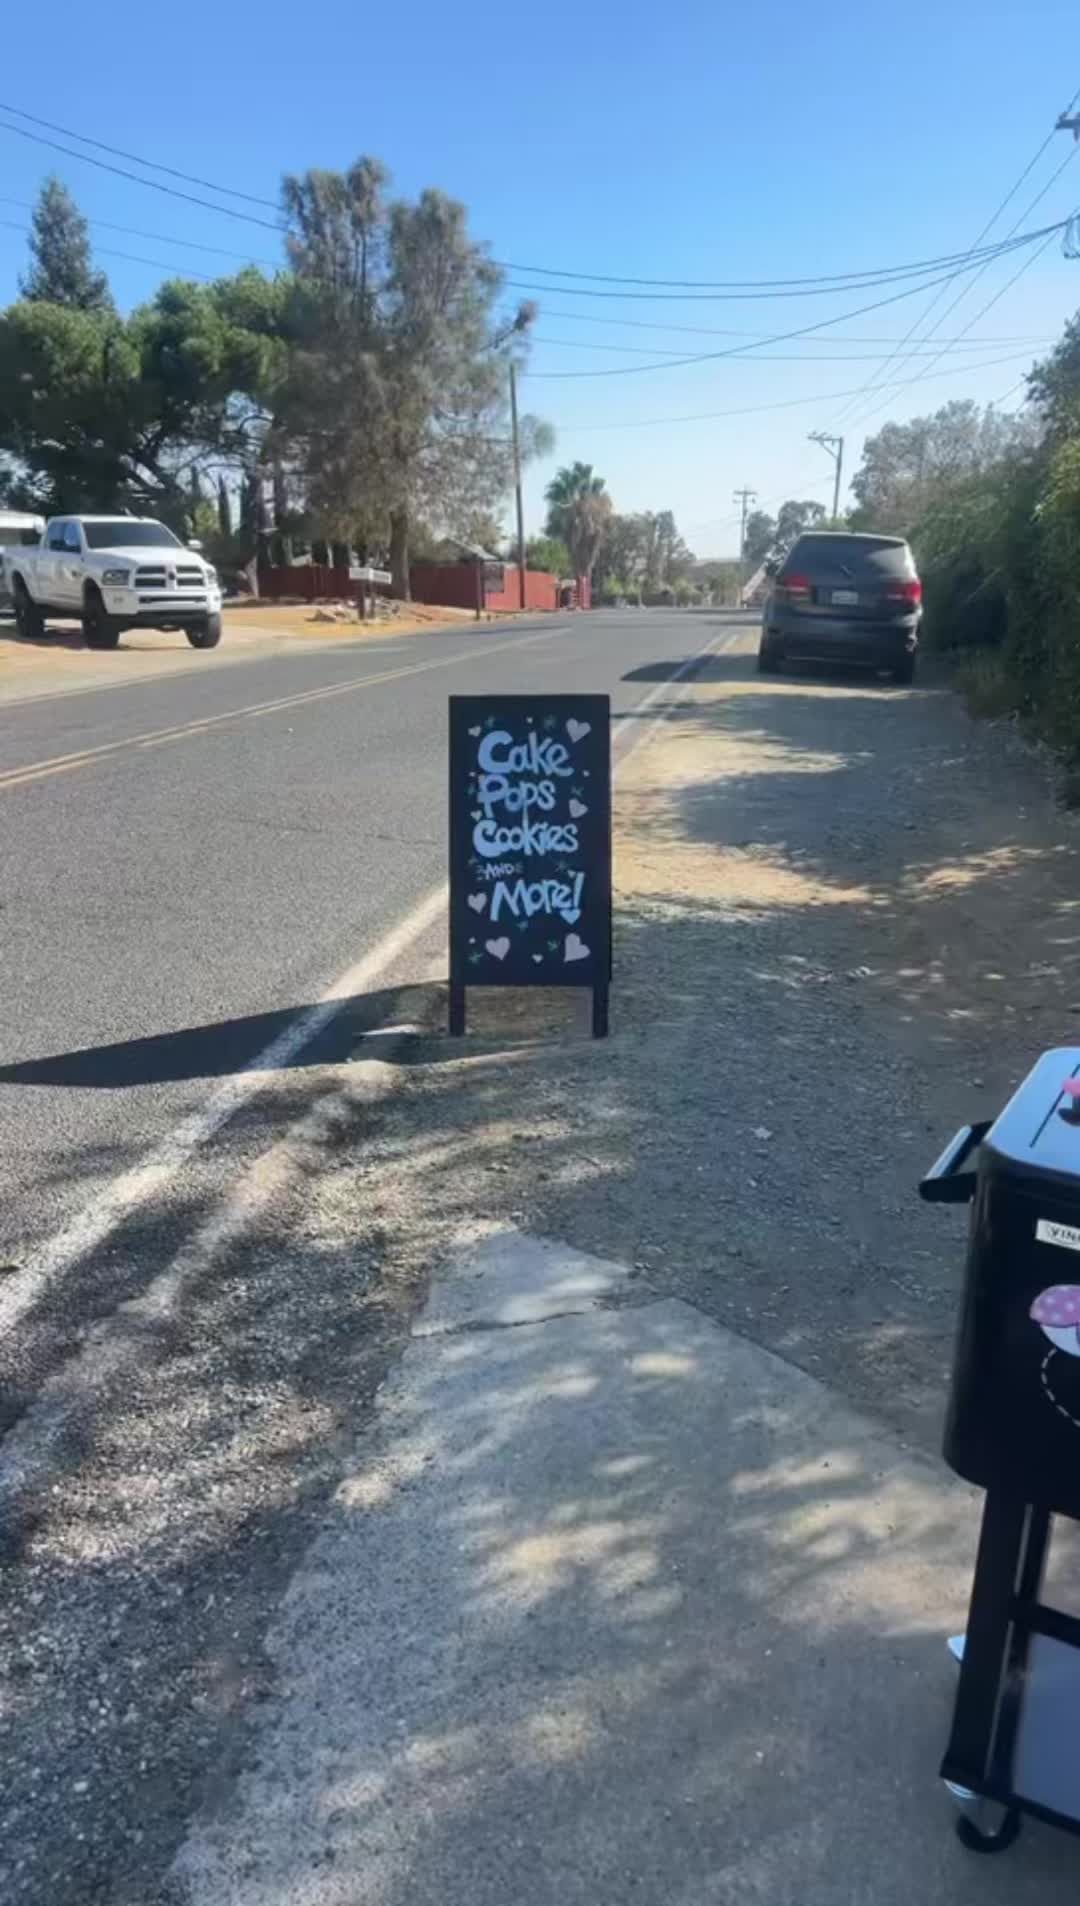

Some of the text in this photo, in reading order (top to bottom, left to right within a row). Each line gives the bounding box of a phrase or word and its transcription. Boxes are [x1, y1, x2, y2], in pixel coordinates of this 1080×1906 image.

[478, 731, 574, 777] Cake
[478, 774, 556, 824] Pops
[472, 818, 579, 858] Cookies
[484, 863, 515, 880] AND
[489, 872, 585, 923] More!
